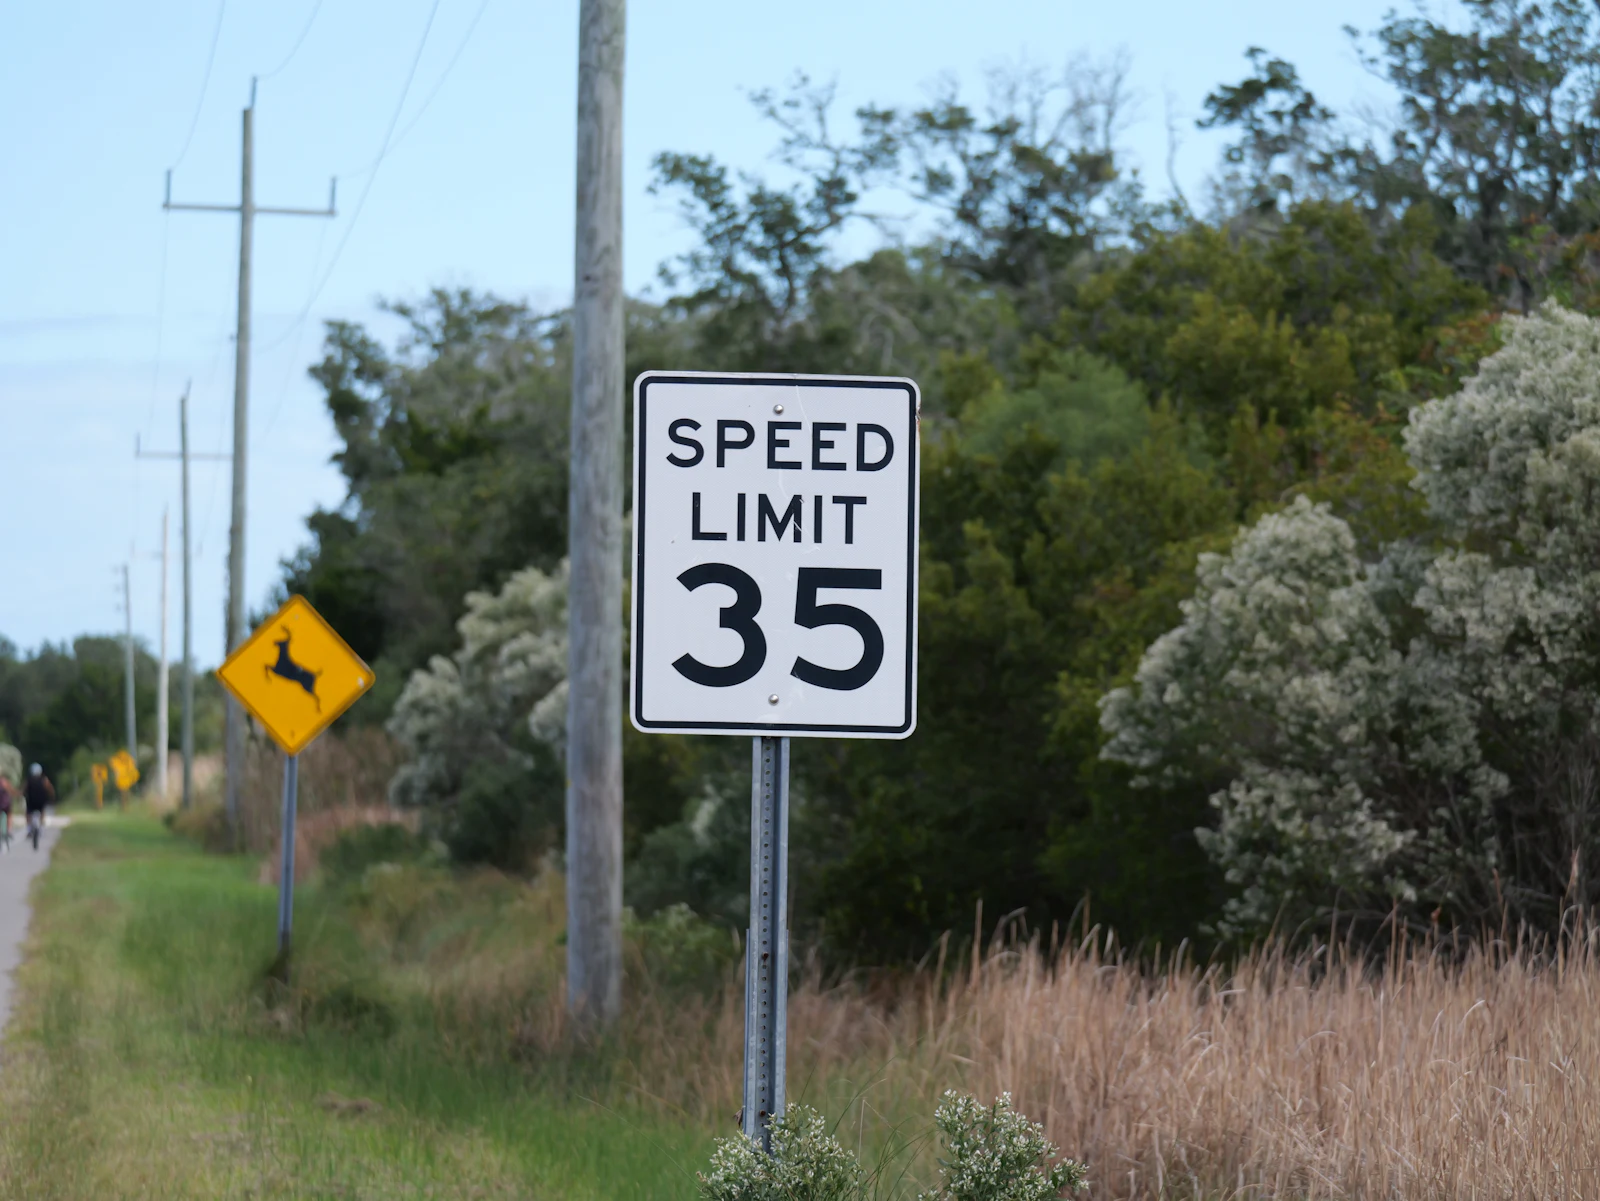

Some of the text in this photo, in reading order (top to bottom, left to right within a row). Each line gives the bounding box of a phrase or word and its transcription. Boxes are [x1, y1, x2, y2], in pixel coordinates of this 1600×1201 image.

[666, 418, 895, 472] SPEED
[691, 491, 867, 545] LIMIT
[671, 562, 885, 691] 35
